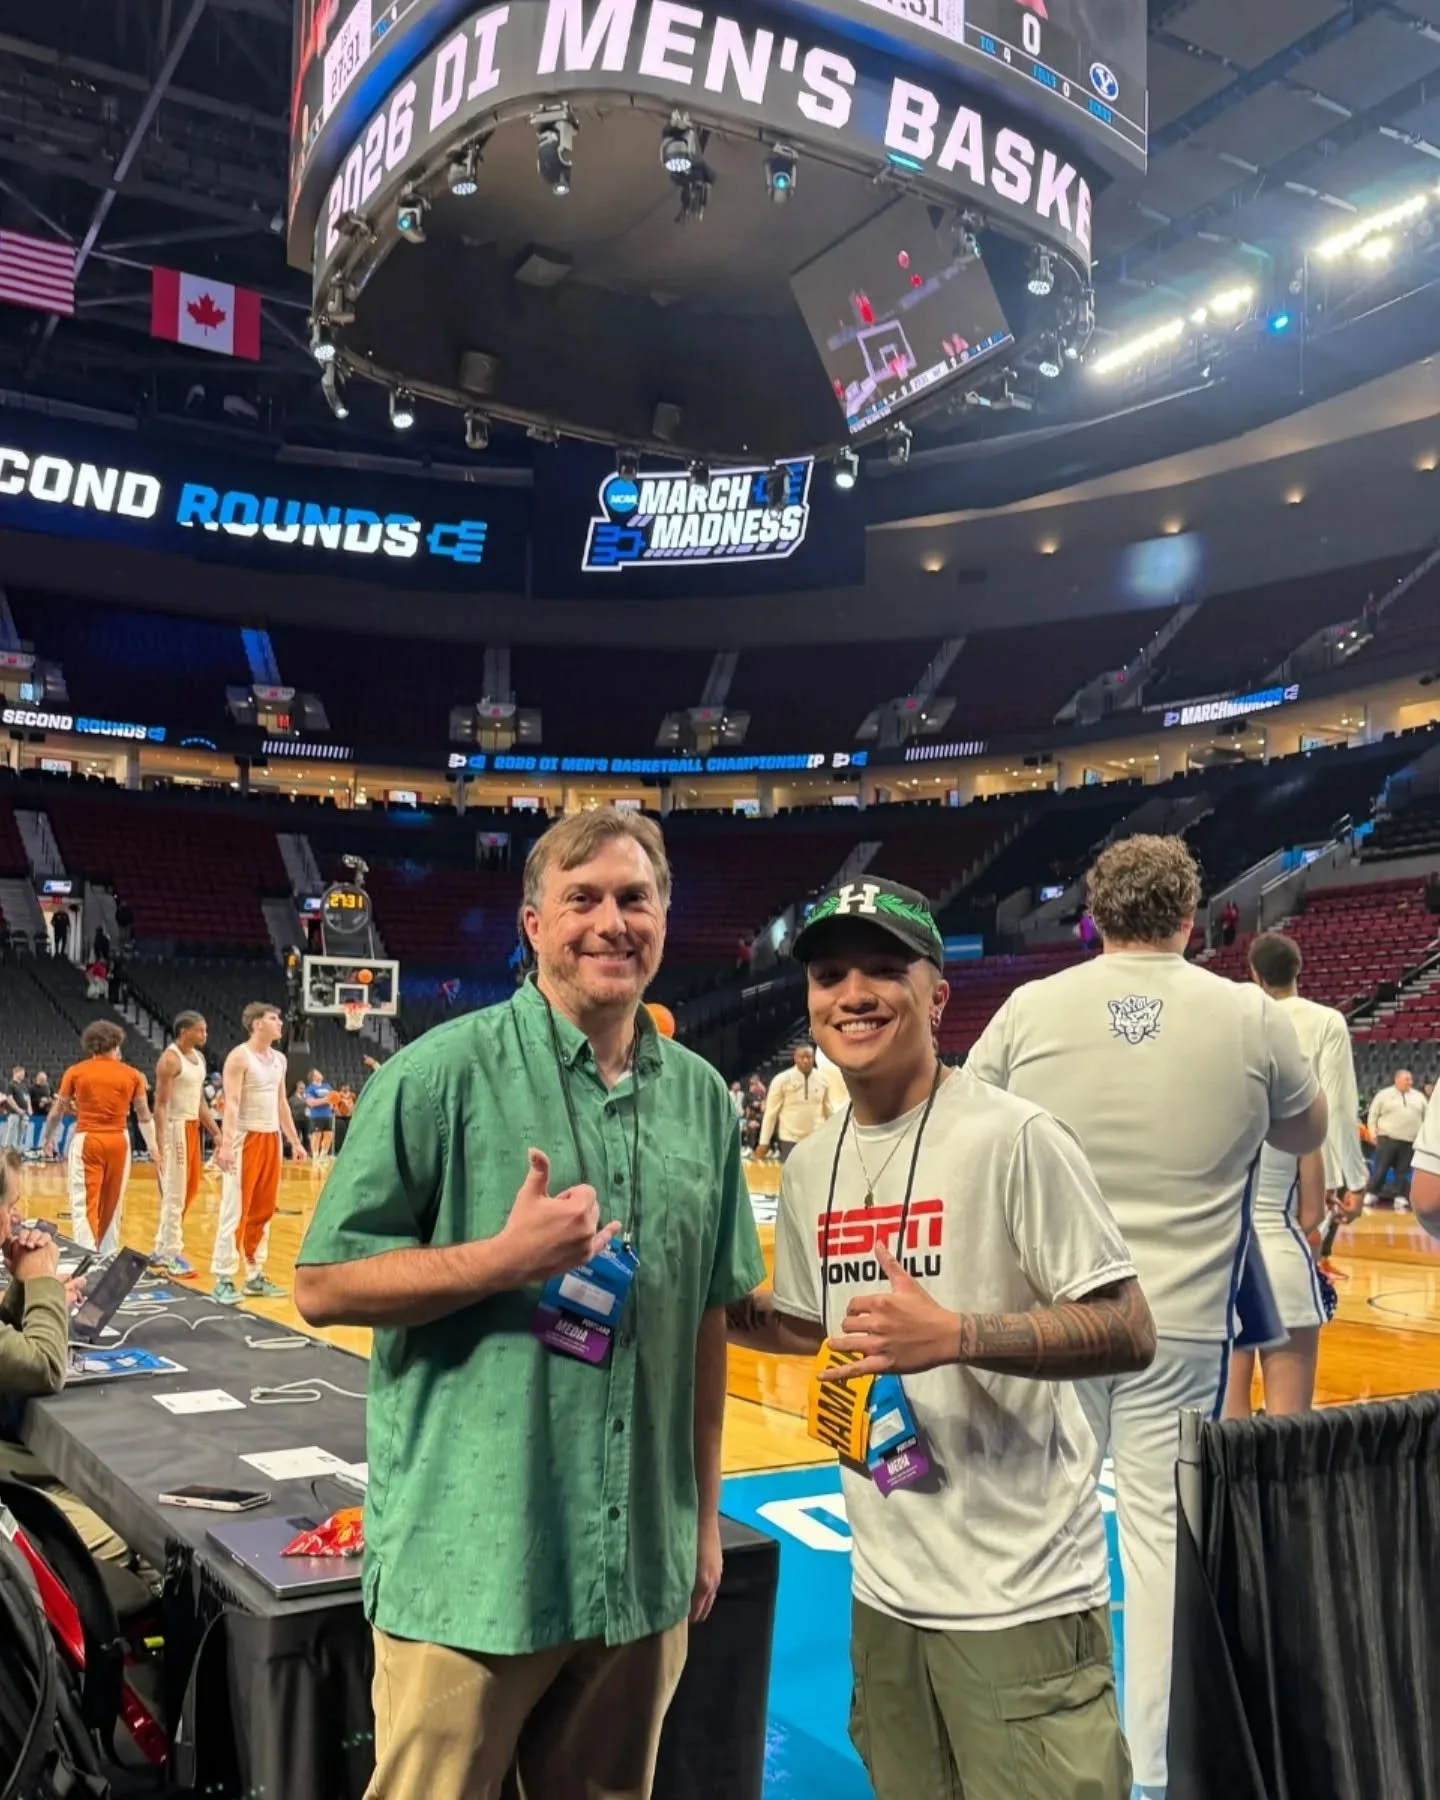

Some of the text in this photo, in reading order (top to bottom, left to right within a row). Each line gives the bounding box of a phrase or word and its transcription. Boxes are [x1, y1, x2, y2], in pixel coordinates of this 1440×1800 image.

[324, 79, 417, 261] 2026
[429, 3, 512, 133] DI
[537, 0, 857, 130] MEN'S
[638, 474, 753, 515] MARCH
[176, 482, 423, 558] ROUNDS
[650, 504, 804, 550] MADNESS
[2, 708, 148, 740] SECOND ROUNDS
[610, 758, 704, 773] BASKETBALL
[705, 753, 826, 773] CHAMPIONSHIP
[835, 883, 881, 915] H
[817, 1197, 944, 1258] ESPN
[555, 1319, 589, 1343] MEDIA
